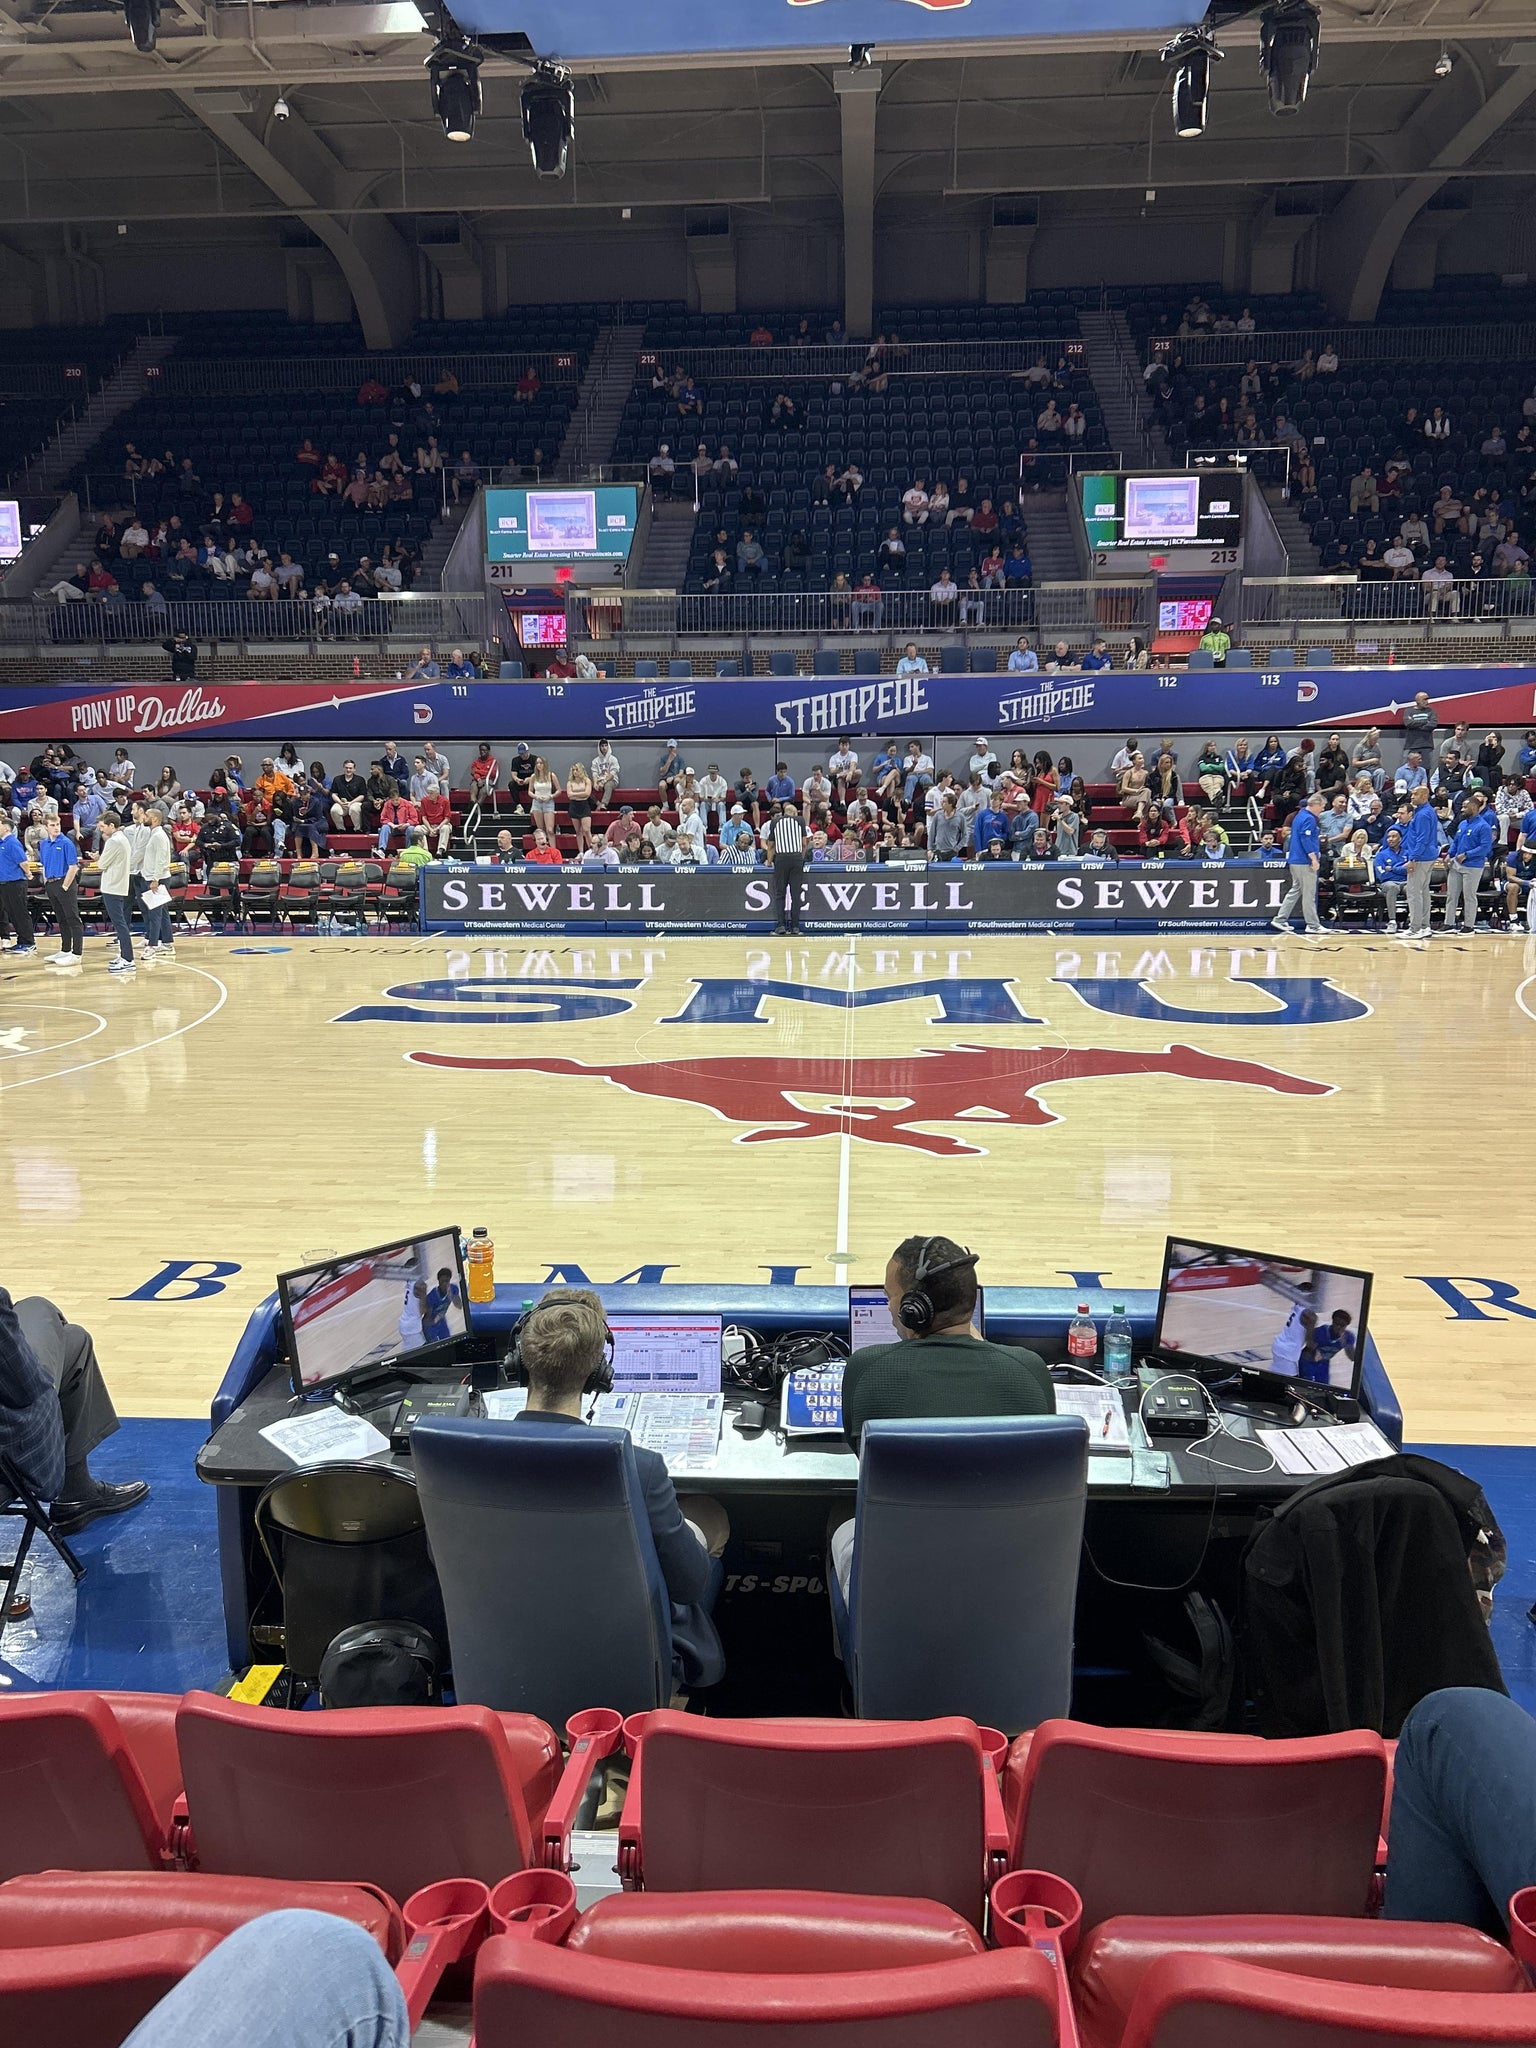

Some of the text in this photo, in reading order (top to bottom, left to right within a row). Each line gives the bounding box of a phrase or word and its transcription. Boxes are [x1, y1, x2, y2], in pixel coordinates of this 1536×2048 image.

[1154, 342, 1170, 350] 213
[558, 358, 571, 366] 211
[146, 368, 159, 376] 211
[1210, 551, 1237, 563] 213
[491, 566, 512, 578] 211
[1158, 677, 1177, 687] 112
[1261, 674, 1280, 686] 113
[452, 686, 467, 696] 111
[546, 686, 564, 696] 112
[1040, 681, 1054, 692] THE
[643, 688, 657, 698] THE
[605, 690, 696, 728] STAMPEDE
[774, 678, 929, 735] STAMPEDE
[998, 684, 1095, 724] STAMPEDE
[72, 687, 226, 733] PONY UP Dallas
[1081, 862, 1104, 870] UTSW
[1141, 862, 1164, 870] UTSW
[442, 880, 665, 911] SEWELL
[310, 946, 452, 956] Origin
[328, 977, 1375, 1026] SMU
